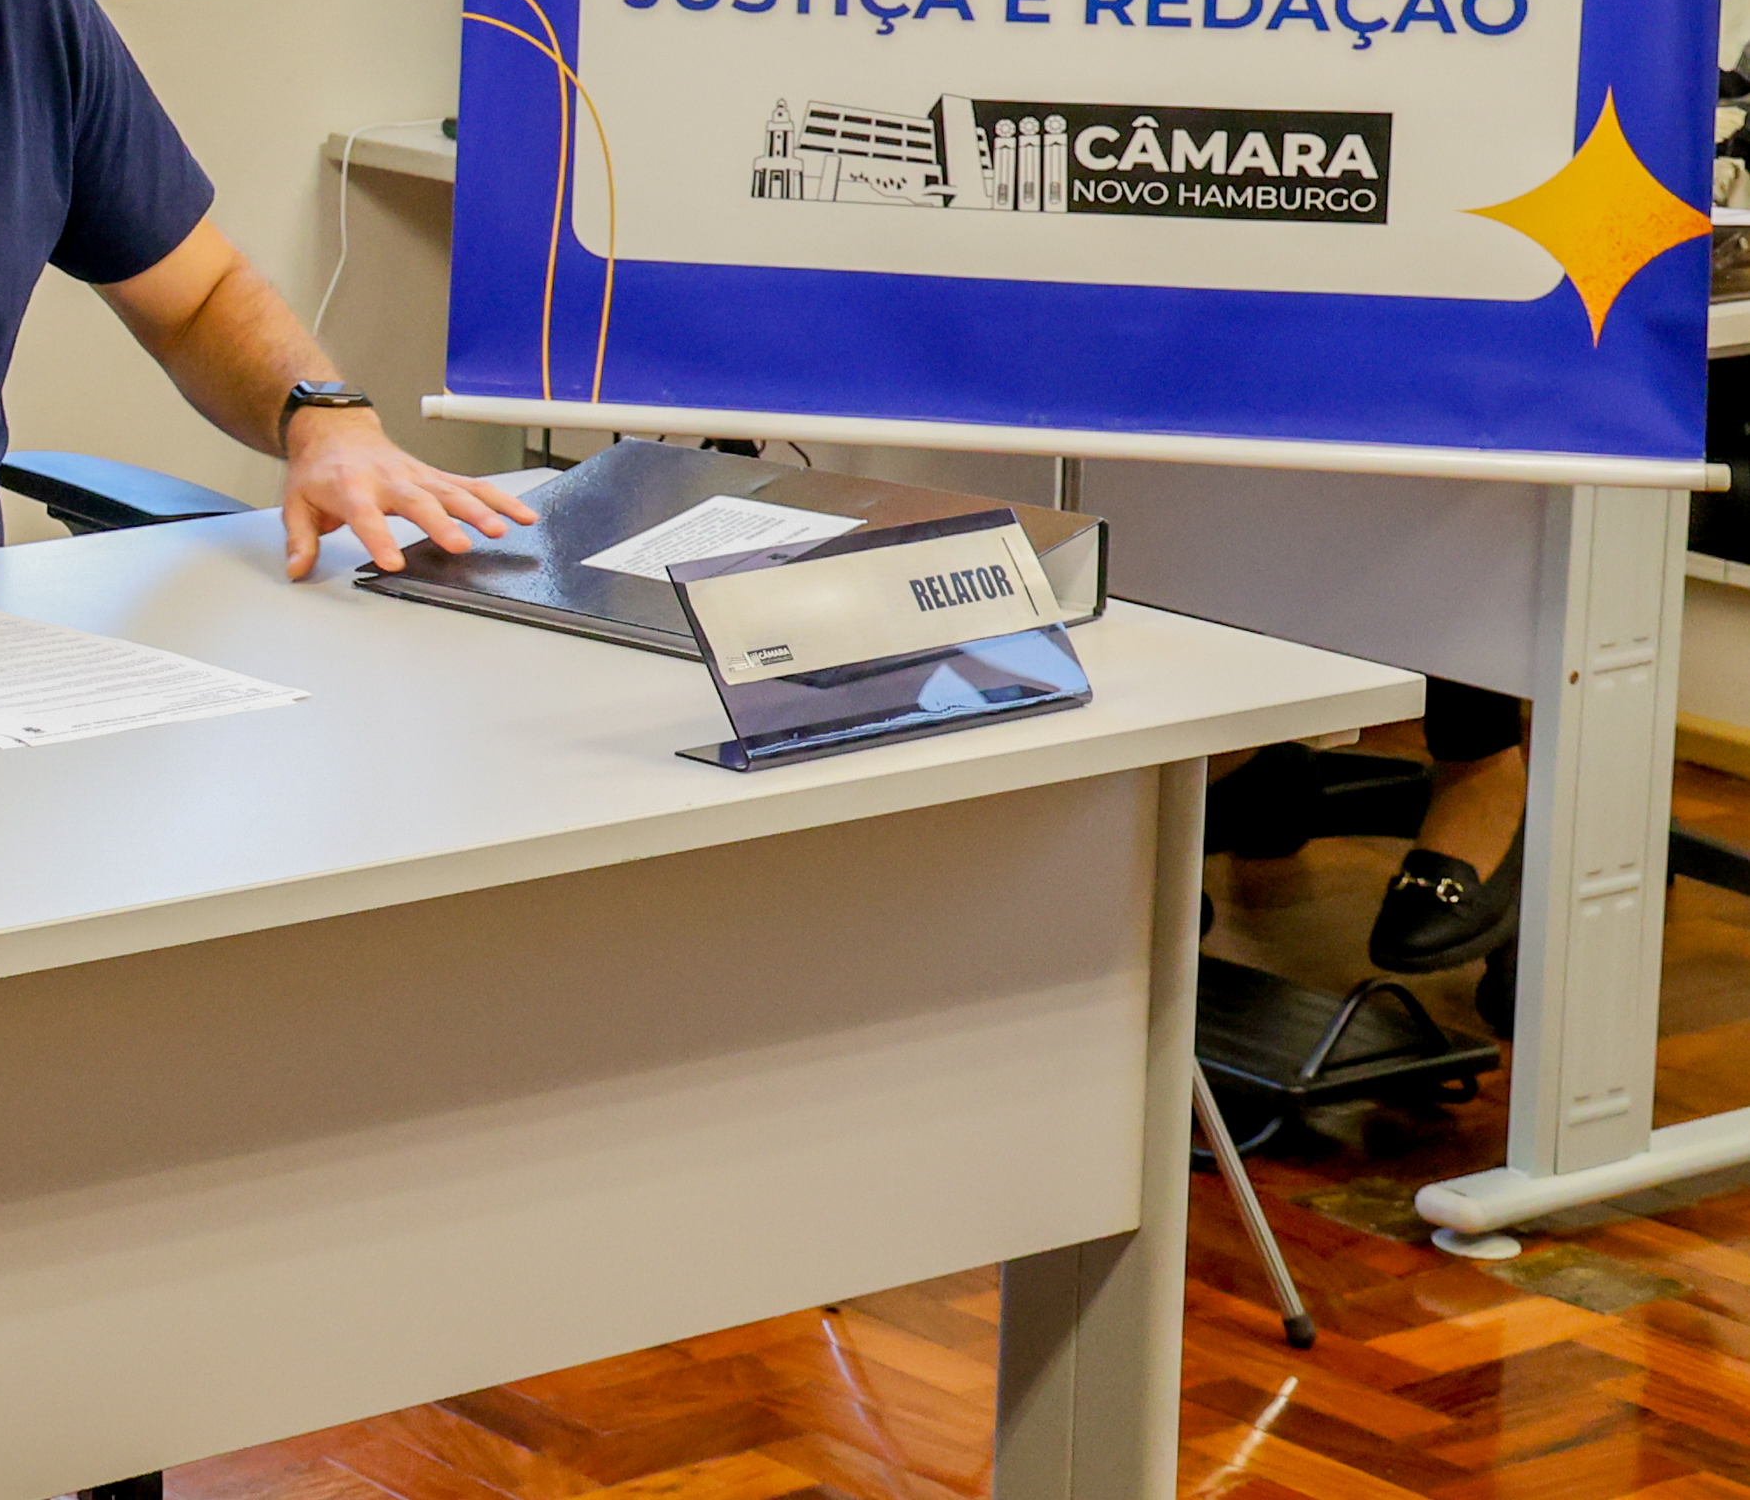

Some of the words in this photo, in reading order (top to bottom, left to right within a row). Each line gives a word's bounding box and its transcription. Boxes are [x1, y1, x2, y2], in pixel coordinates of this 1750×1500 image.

[1074, 115, 1379, 179] CÂMARA
[1073, 179, 1170, 206] NOVO
[1178, 183, 1377, 212] HAMBURGO
[909, 565, 1014, 612] RELATOR
